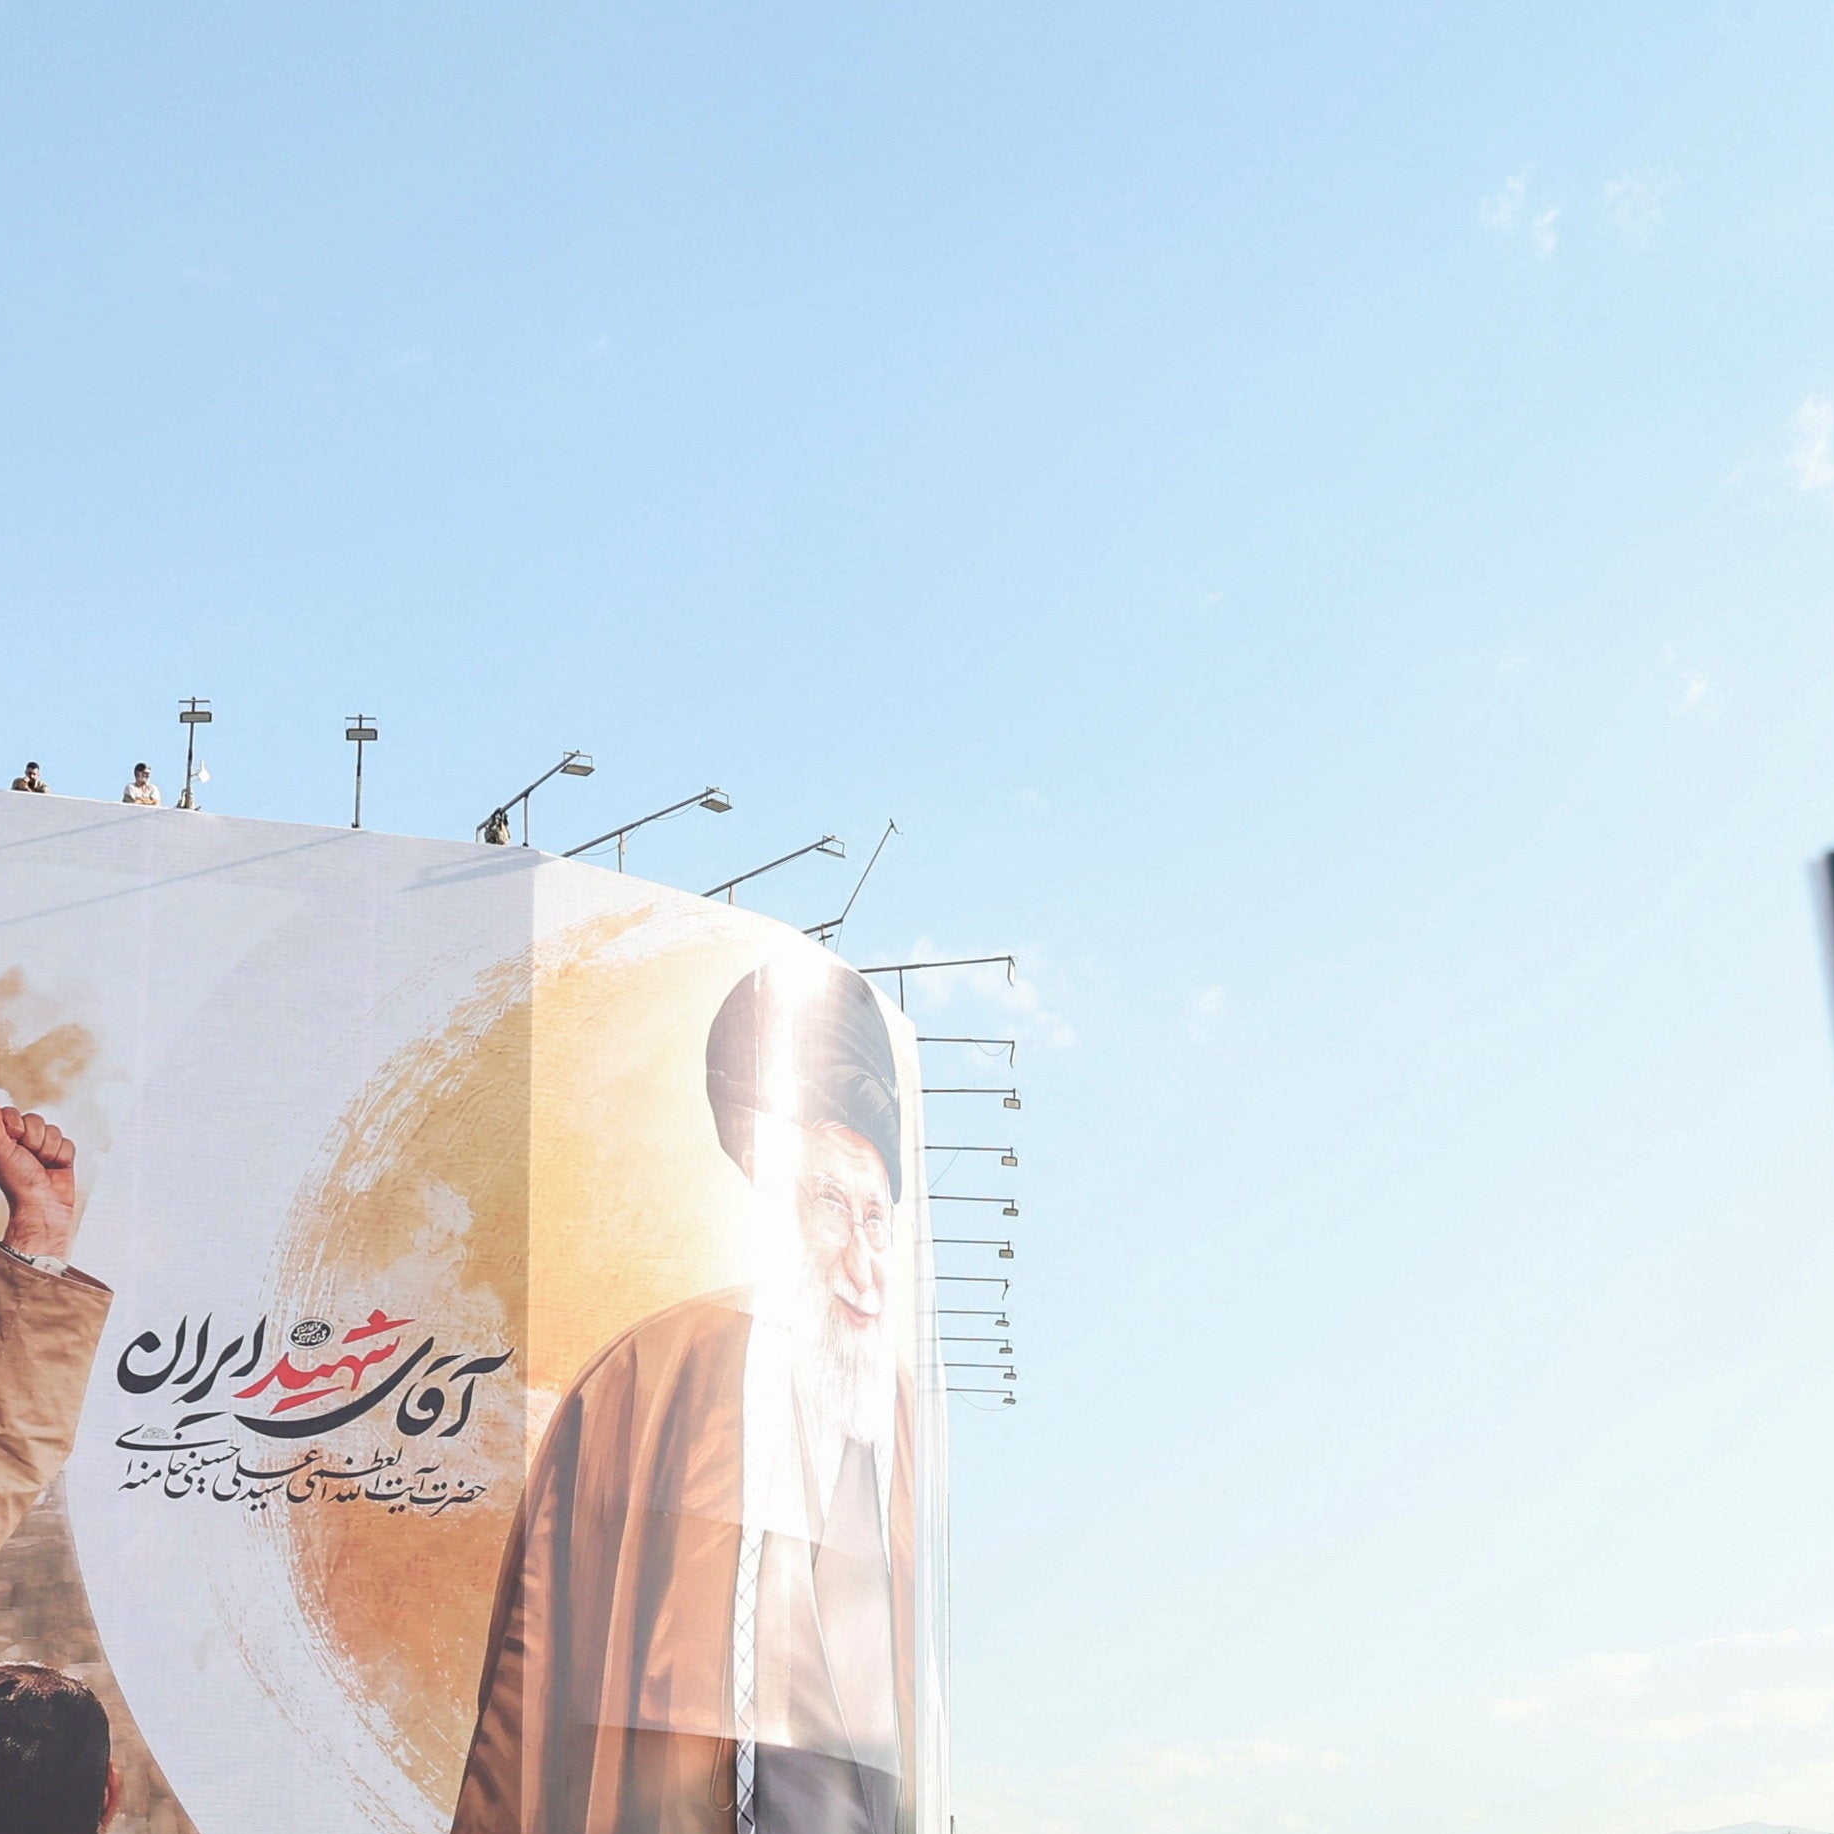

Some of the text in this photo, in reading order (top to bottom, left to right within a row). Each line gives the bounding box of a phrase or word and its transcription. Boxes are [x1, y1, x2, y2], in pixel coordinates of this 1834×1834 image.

[117, 1309, 515, 1438] آقای شهید ایران
[212, 1449, 323, 1501] علی
[409, 1480, 487, 1517] حضرت
